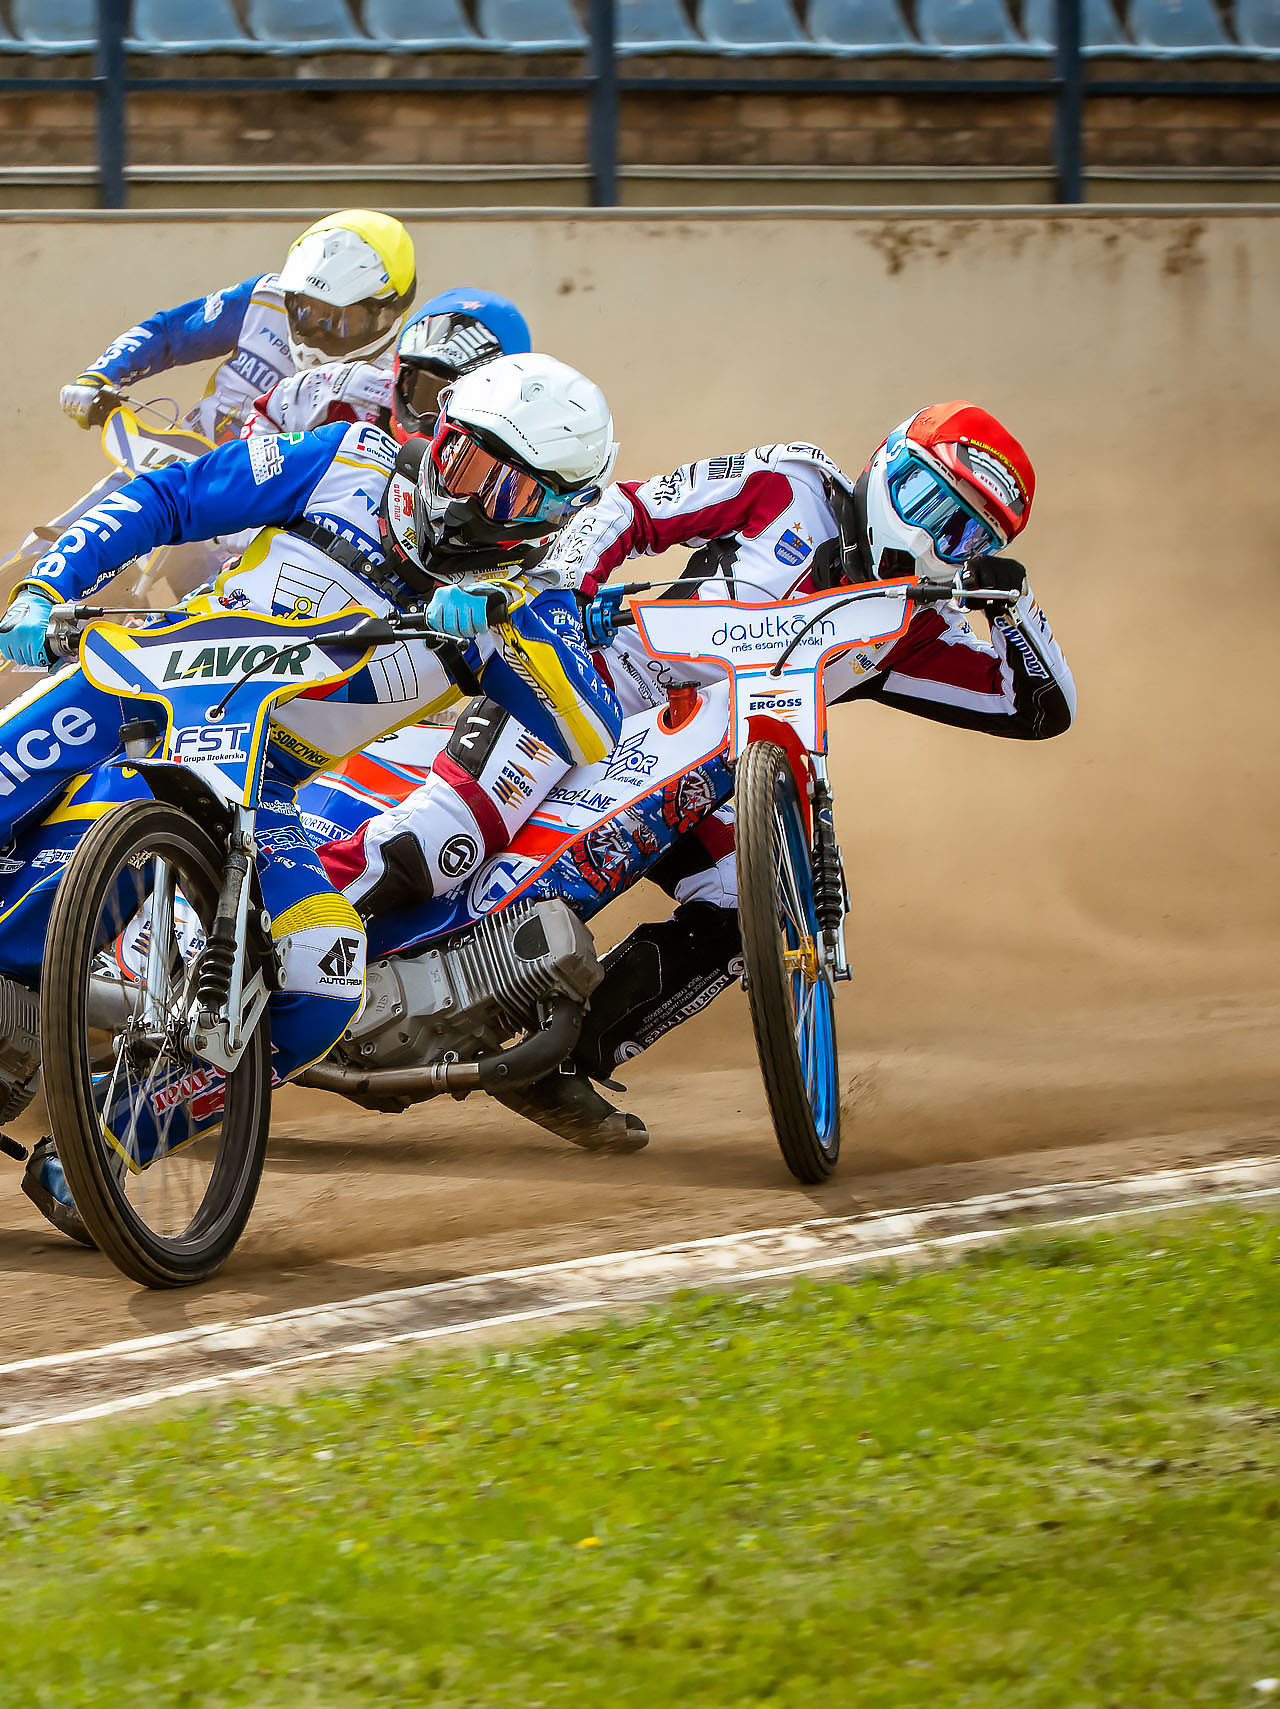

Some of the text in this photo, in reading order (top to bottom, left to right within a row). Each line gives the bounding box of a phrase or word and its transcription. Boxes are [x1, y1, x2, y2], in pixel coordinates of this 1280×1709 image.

[86, 326, 153, 371] Nice
[359, 427, 402, 460] FS
[31, 491, 143, 578] Nice
[731, 641, 753, 653] mēs
[755, 641, 784, 650] esam
[163, 644, 311, 682] LAVOR
[749, 698, 802, 711] ERGOSS
[175, 726, 247, 753] FST
[183, 755, 206, 764] Grupa
[501, 765, 533, 798] ERGOSS
[333, 827, 353, 841] TY
[318, 977, 346, 985] AUTO
[684, 974, 729, 1016] NORTH
